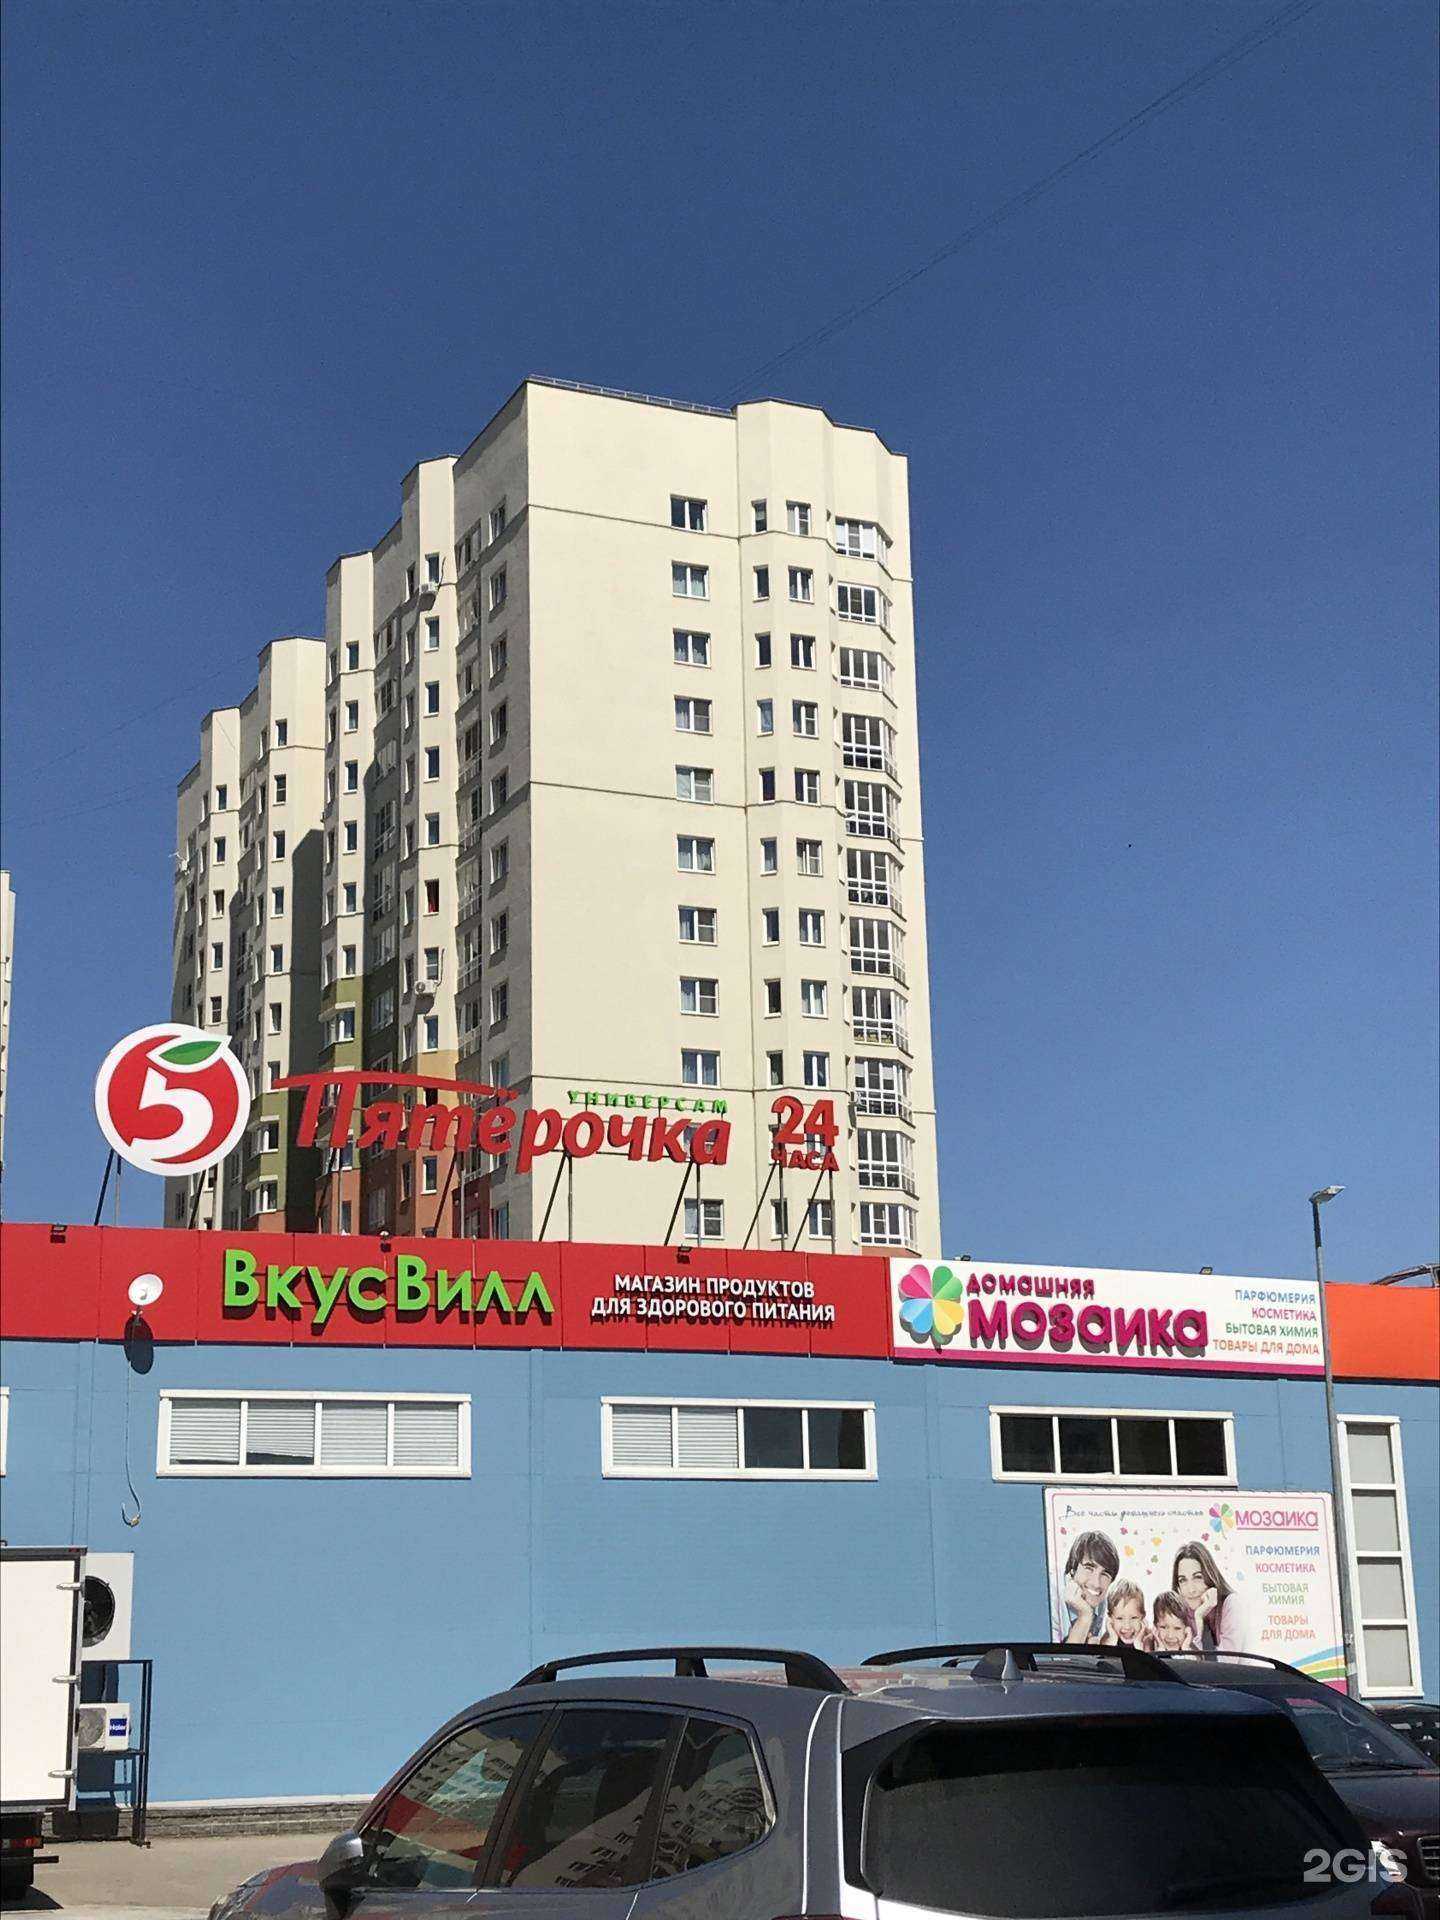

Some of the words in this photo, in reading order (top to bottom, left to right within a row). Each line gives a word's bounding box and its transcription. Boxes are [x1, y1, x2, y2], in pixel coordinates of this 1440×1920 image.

[567, 1090, 728, 1114] УНИВЕРСАМ
[273, 1070, 732, 1175] Пятёрочка
[771, 1096, 839, 1147] 24
[771, 1149, 839, 1172] ЧАСА
[223, 1249, 555, 1324] ВкусВилл
[614, 1274, 700, 1294] МАГАЗИН
[706, 1277, 815, 1299] ПРОДУКТОВ
[1234, 1289, 1317, 1305] ПАРФЮМЕРИЯ
[591, 1298, 631, 1317] ДЛЯ
[637, 1299, 747, 1319] ЗДОРОВОГО
[752, 1302, 836, 1321] ПИТАНИЯ
[1251, 1307, 1318, 1322] КОСМЕТИКА
[1225, 1322, 1277, 1337] БЫТОВАЯ
[1279, 1325, 1320, 1339] ХИМИЯ
[1212, 1339, 1259, 1354] ТОВАРЫ
[1260, 1342, 1284, 1355] ДЛЯ
[1286, 1343, 1321, 1357] ДОМА
[1246, 1545, 1320, 1557] ПАРФЮМЕРИЯ
[1255, 1563, 1317, 1575] КОСМЕТИКА
[1262, 1583, 1309, 1594] БЫТОВАЯ
[1268, 1595, 1305, 1606] ХИМИЯ
[1268, 1615, 1309, 1626] ТОВАРЫ
[1261, 1629, 1283, 1641] ДЛЯ
[1285, 1629, 1317, 1642] ДОМА
